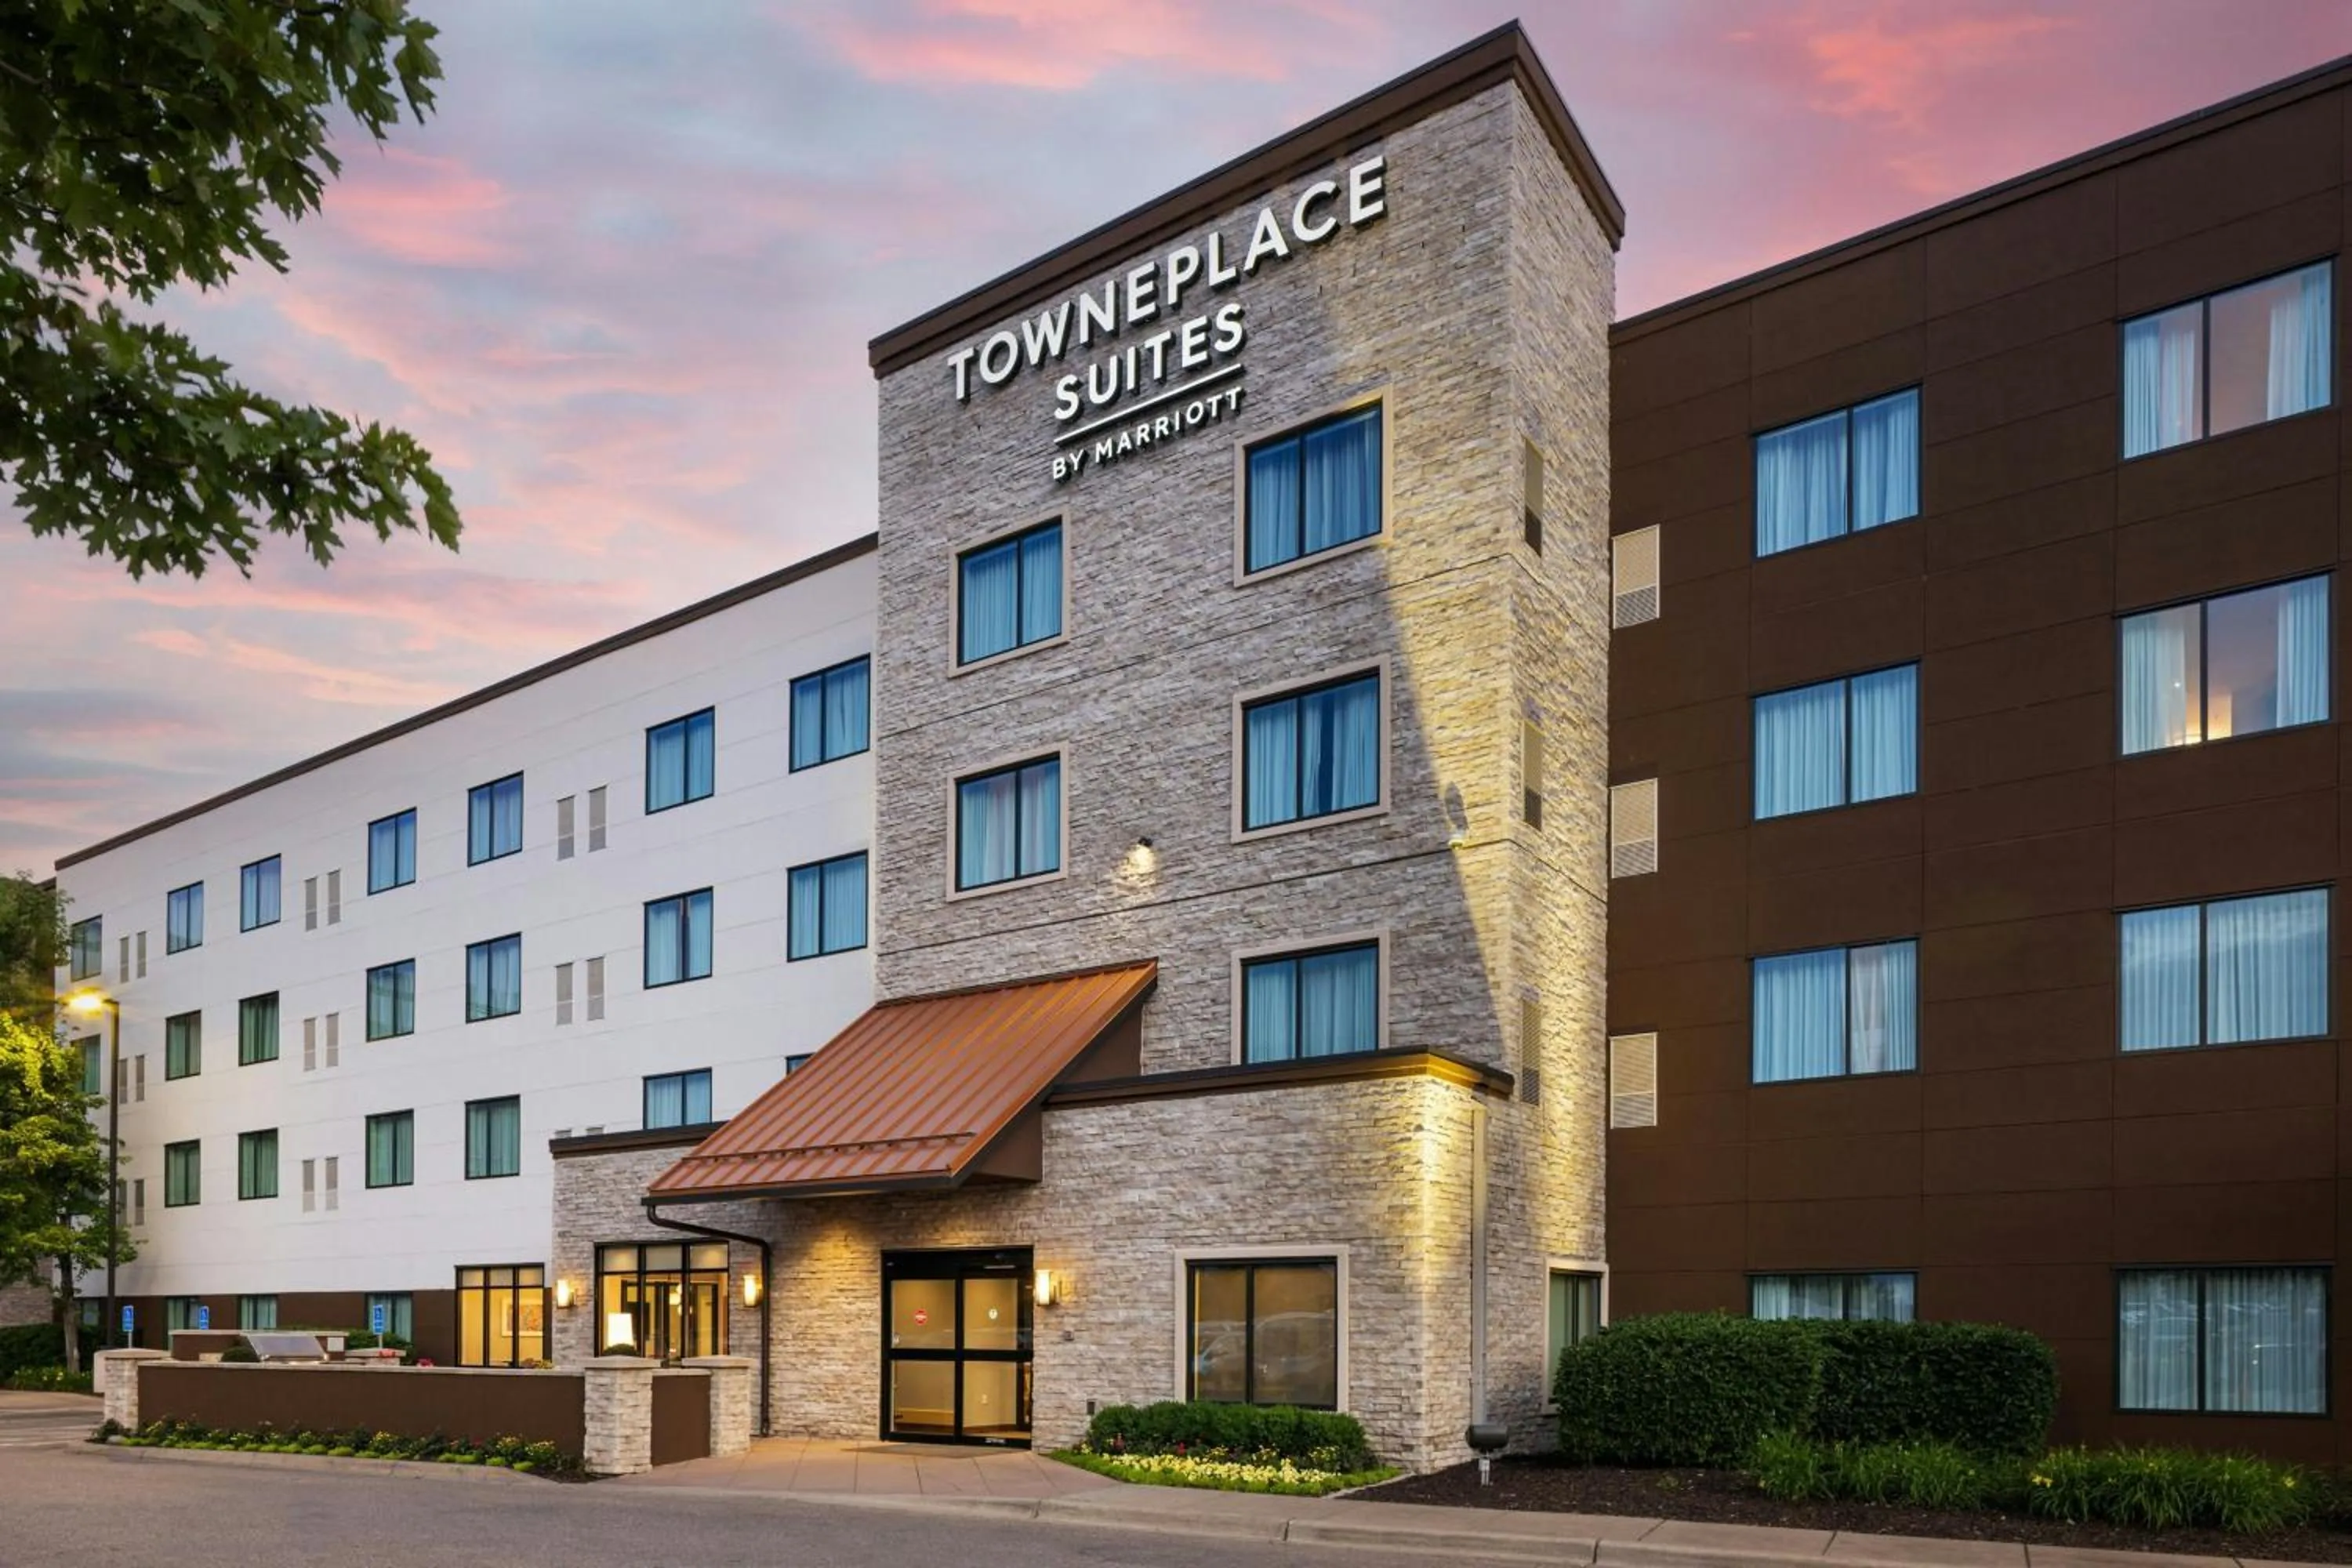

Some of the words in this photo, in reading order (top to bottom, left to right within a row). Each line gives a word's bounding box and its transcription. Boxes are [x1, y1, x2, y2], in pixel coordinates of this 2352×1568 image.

[947, 155, 1386, 401] TOWNEPLACE
[1054, 303, 1246, 420] SUITES
[1052, 450, 1086, 481] BY
[1094, 387, 1245, 465] MARRIOTT
